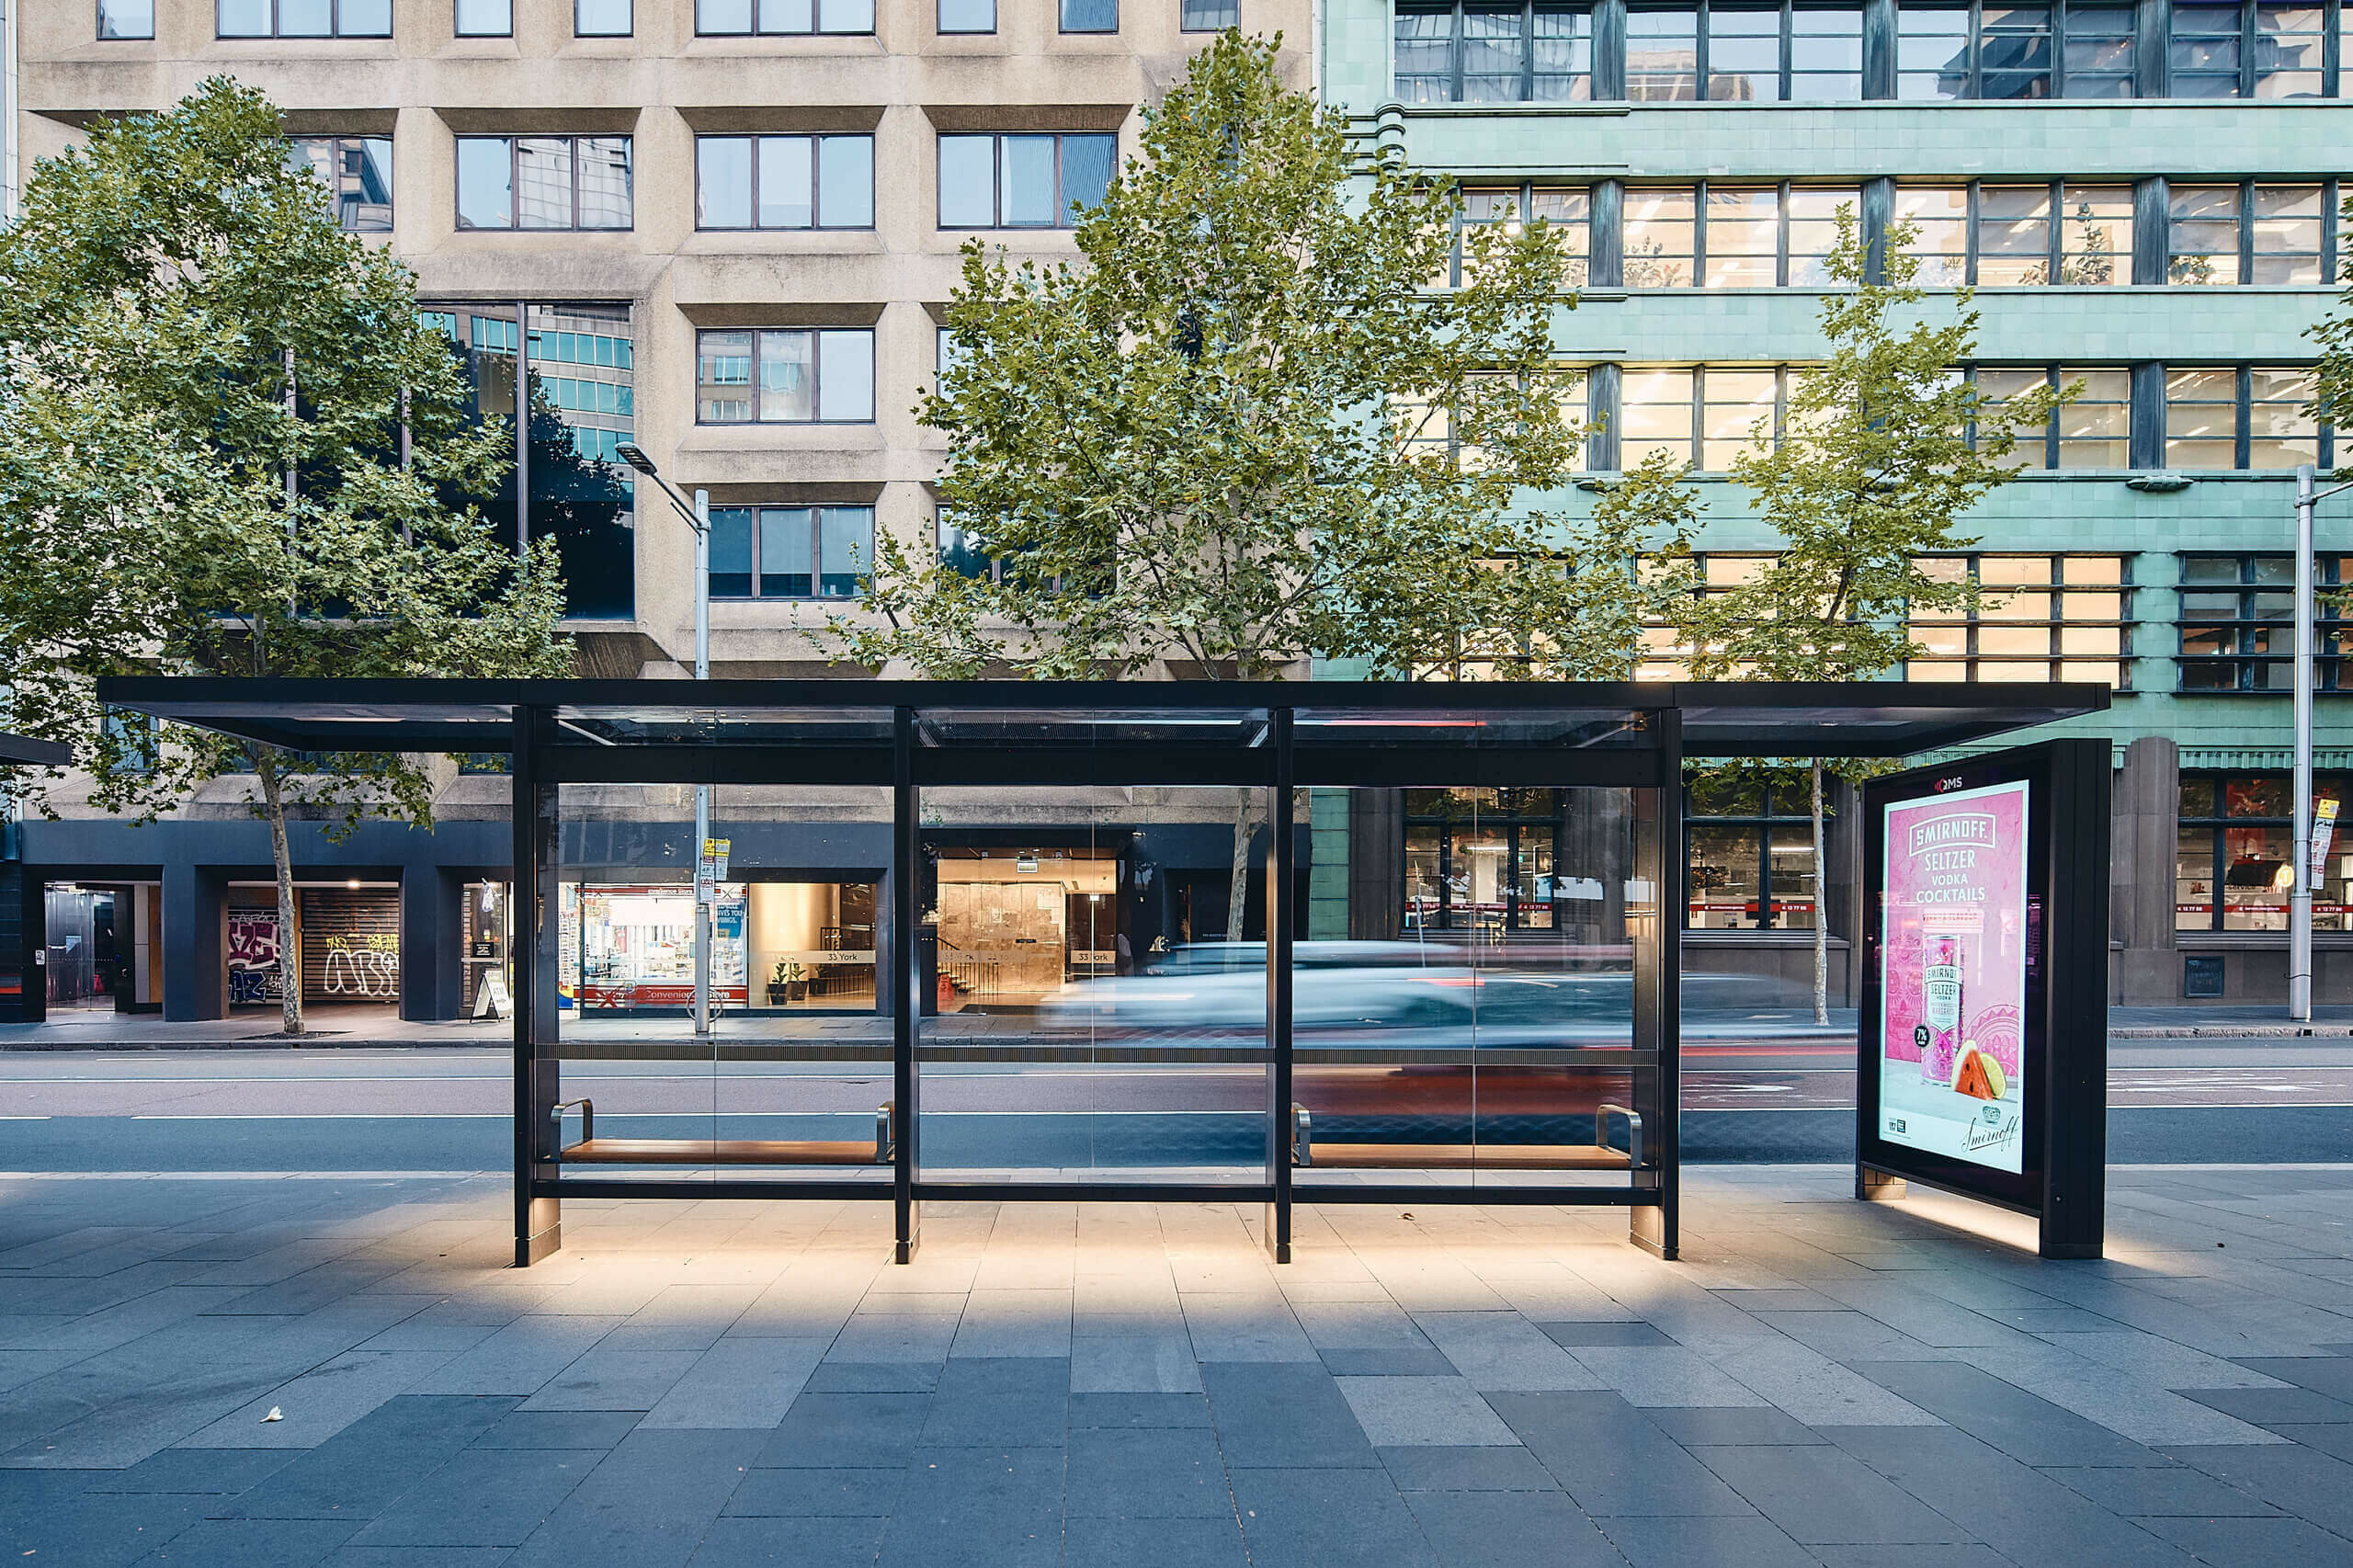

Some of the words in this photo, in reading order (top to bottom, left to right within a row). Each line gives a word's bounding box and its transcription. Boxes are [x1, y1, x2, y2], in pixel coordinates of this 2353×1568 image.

[1925, 849, 1975, 871] SELTZER
[1931, 873, 1968, 886] VODKA
[1916, 886, 1985, 903] COCKTAILS
[839, 953, 857, 961] York
[1079, 953, 1088, 961] 33
[1090, 952, 1108, 961] ork
[1930, 983, 1957, 995] SELTZER
[1916, 1028, 1927, 1041] 7%
[1961, 1116, 2019, 1153] Smirnoff
